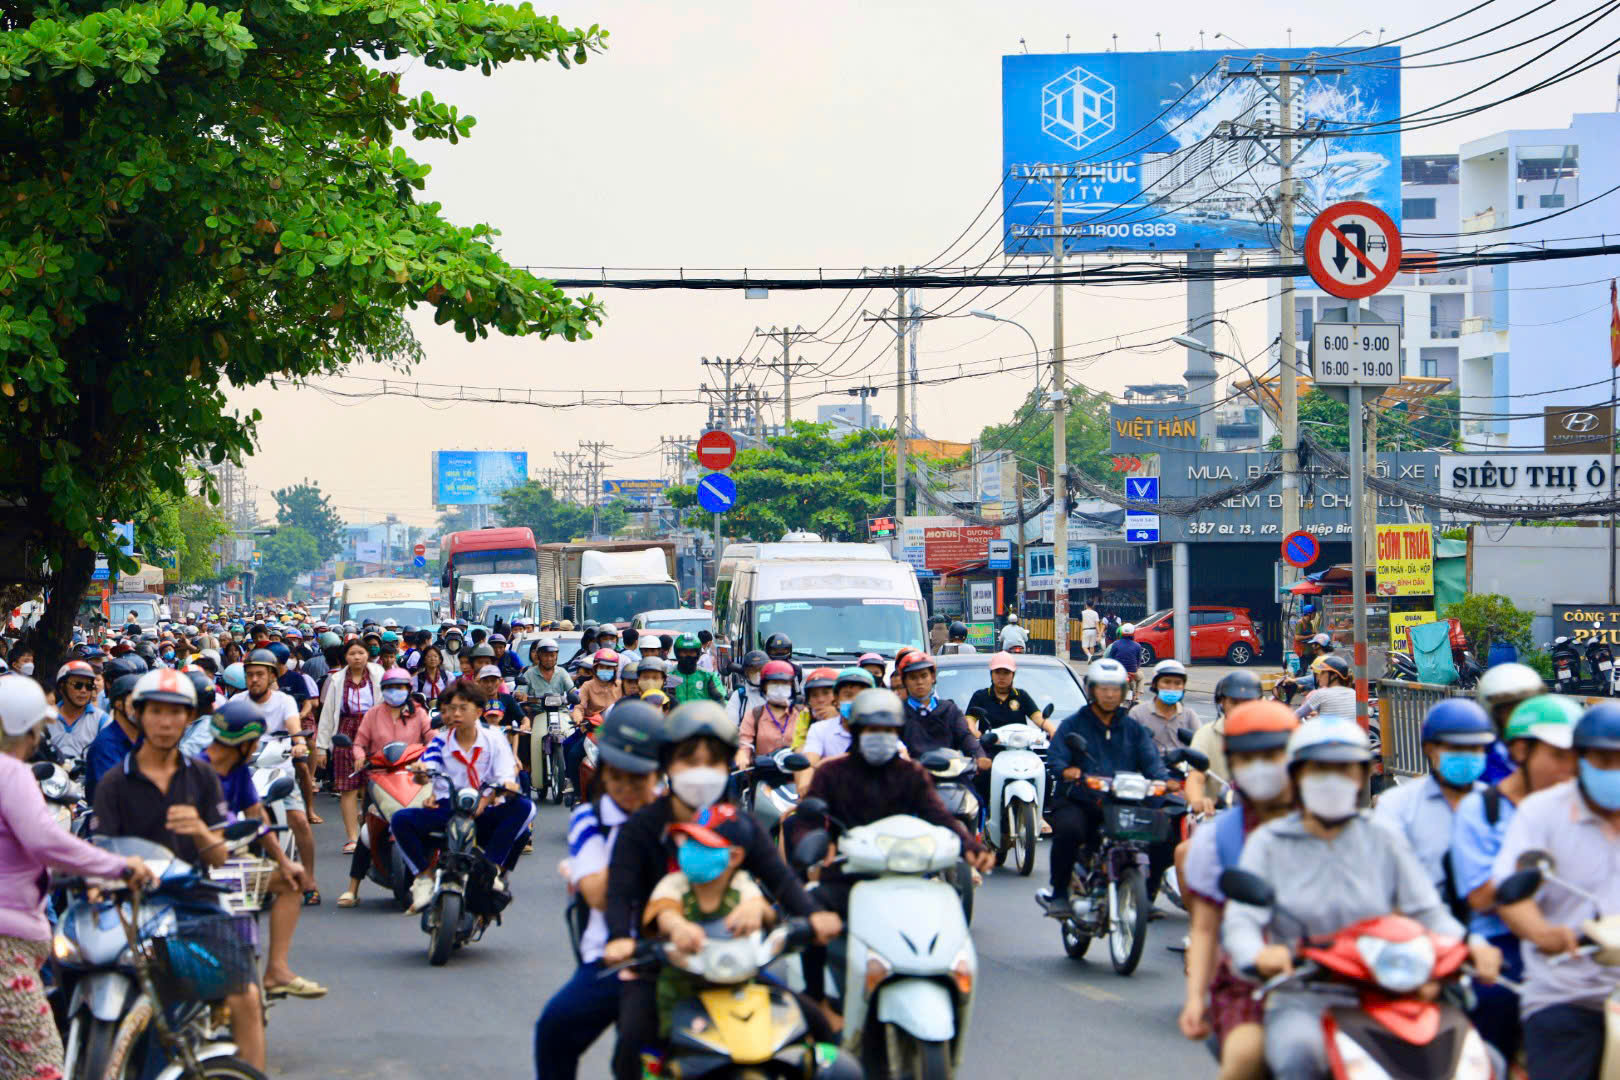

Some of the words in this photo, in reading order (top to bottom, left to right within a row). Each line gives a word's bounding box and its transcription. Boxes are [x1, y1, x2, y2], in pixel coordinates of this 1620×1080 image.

[1089, 224, 1130, 238] 1800
[1132, 223, 1177, 237] 6363
[1324, 336, 1349, 351] 6:00
[1362, 336, 1390, 351] 9:00
[1321, 361, 1349, 376] 16:00
[1362, 361, 1393, 377] 19:00
[1116, 416, 1154, 440] VIỆT
[1158, 415, 1197, 437] HÀN
[1400, 464, 1425, 479] XE
[1452, 460, 1518, 488] SIÊU
[1526, 465, 1577, 492] THỊ
[1586, 459, 1606, 488] Ô
[1189, 522, 1216, 534] 387
[1218, 524, 1235, 534] QL
[1239, 524, 1255, 535] 13,
[1305, 523, 1333, 536] Hiệp
[1563, 609, 1606, 623] CÔNG
